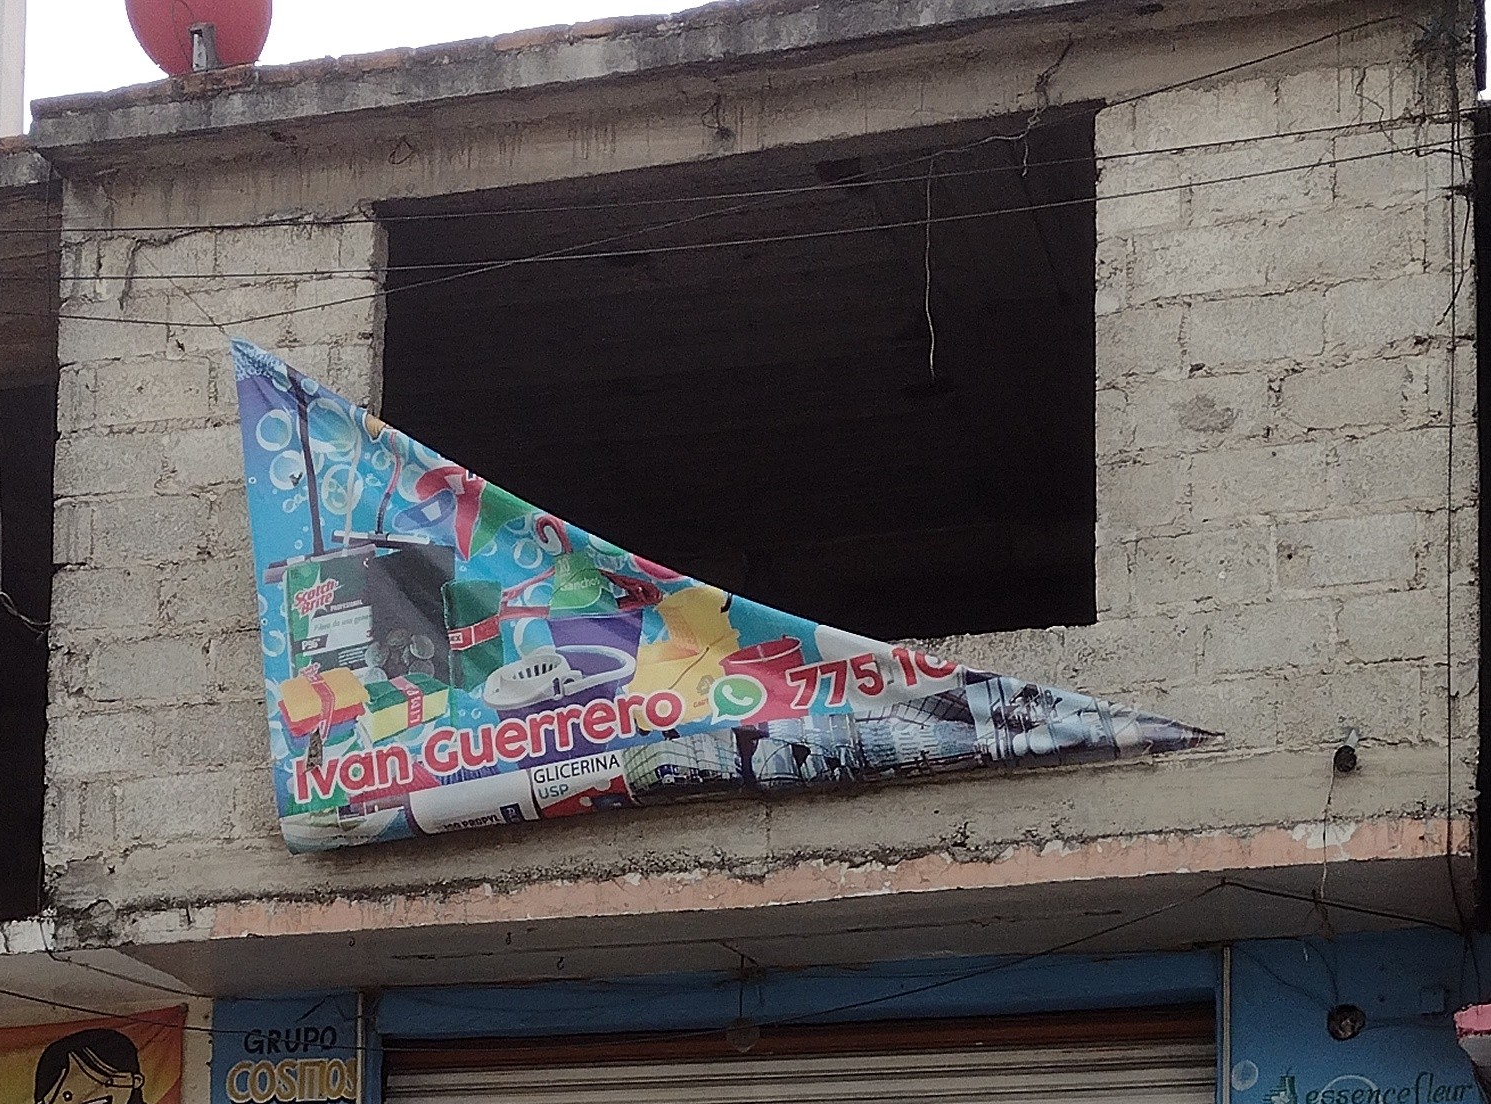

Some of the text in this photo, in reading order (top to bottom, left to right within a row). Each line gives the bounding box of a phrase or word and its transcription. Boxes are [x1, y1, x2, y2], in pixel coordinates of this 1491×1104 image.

[787, 651, 885, 709] 775
[293, 690, 685, 804] Ivan Guerrero
[534, 753, 621, 784] GLICERINA
[537, 783, 570, 800] USP
[243, 1026, 337, 1055] GRUPO
